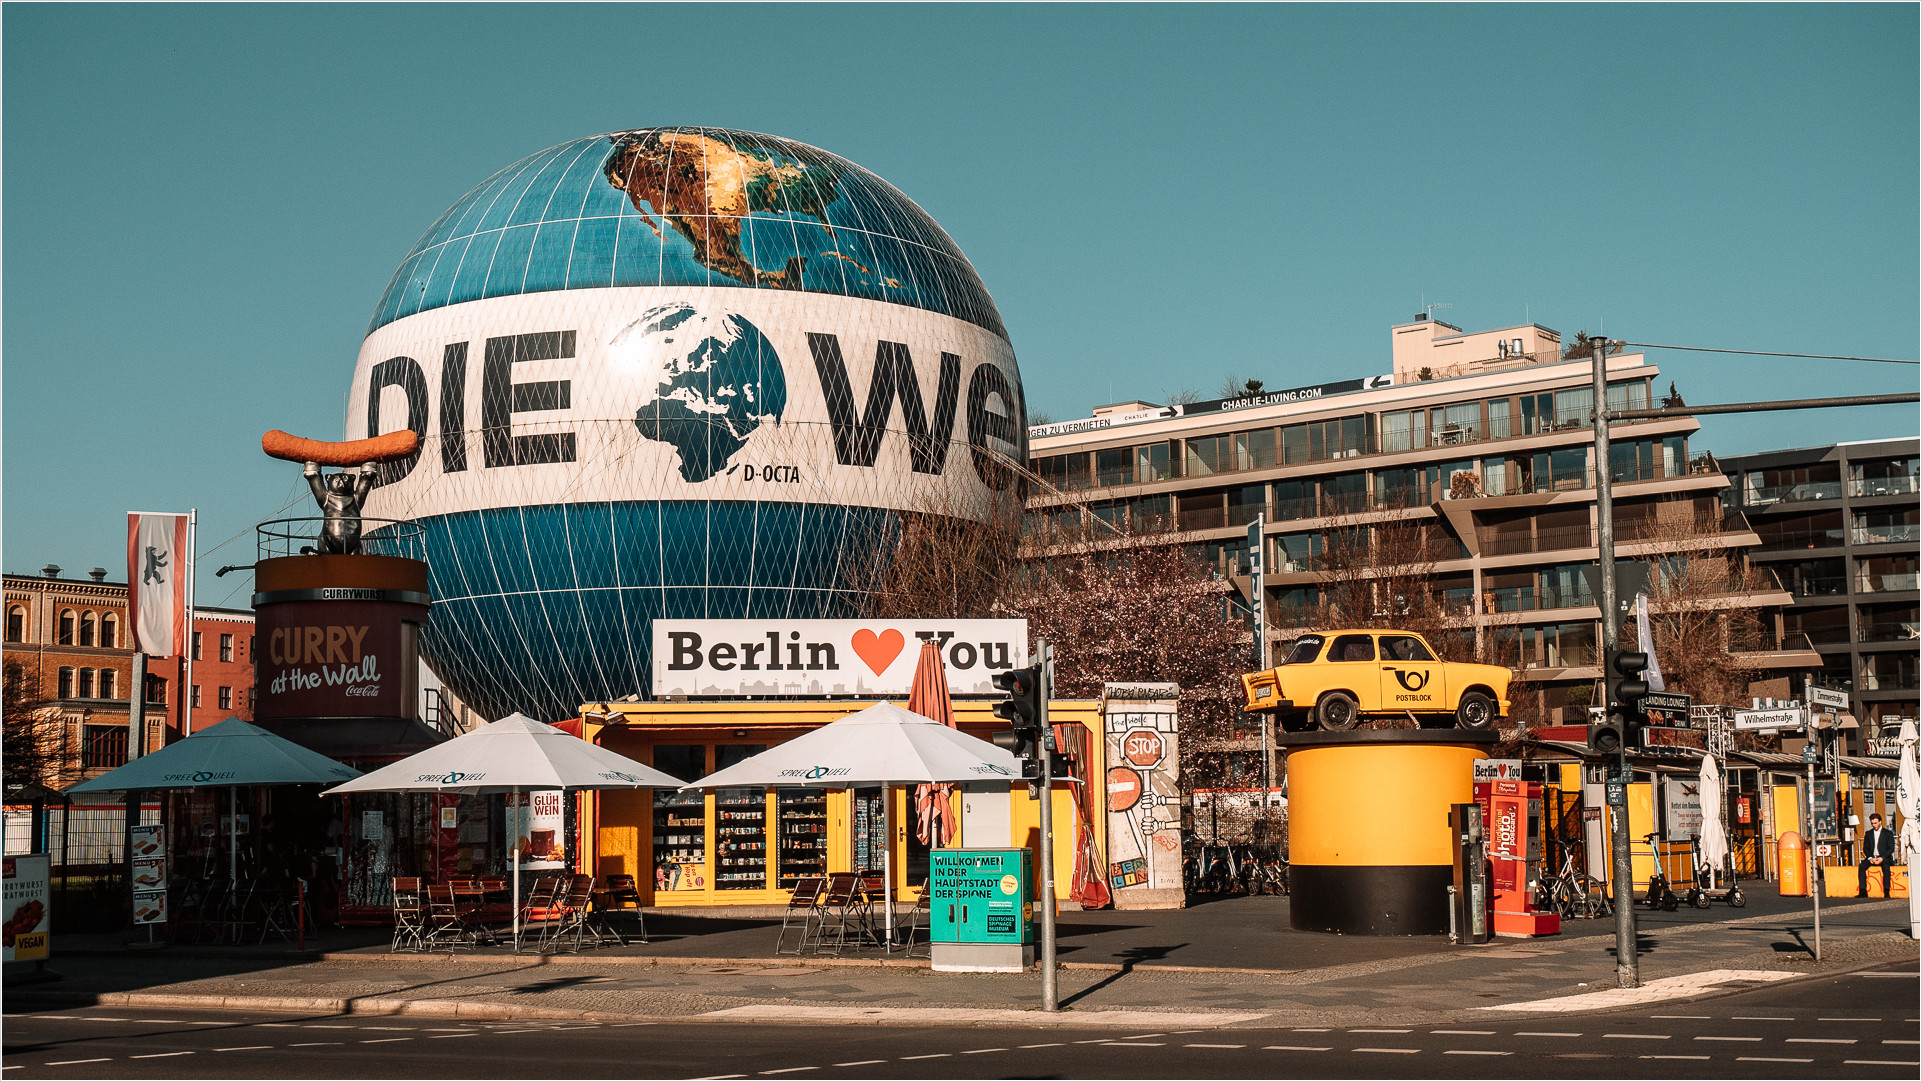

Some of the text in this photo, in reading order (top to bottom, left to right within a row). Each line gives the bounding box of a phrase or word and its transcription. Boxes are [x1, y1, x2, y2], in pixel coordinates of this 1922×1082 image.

[1221, 386, 1322, 411] CHARLIE-LIVING.COM
[368, 330, 577, 488] DIE
[1049, 426, 1061, 435] ZU
[1062, 418, 1111, 433] VERMIETEN
[322, 588, 386, 600] CURRYWURST
[270, 625, 369, 666] CURRY
[668, 631, 840, 671] Berlin
[271, 655, 382, 694] at the Wall
[1395, 694, 1432, 702] POSTBLOCK
[1645, 696, 1666, 706] LANDING
[1667, 697, 1686, 708] LOUNGE
[1743, 712, 1793, 724] Wilhelmstraße
[1128, 737, 1161, 755] STOP
[1475, 764, 1521, 778] Berlin You
[534, 793, 559, 806] GLÜH
[534, 805, 559, 816] WEIN
[935, 857, 1004, 866] WILLKOMMEN
[935, 868, 967, 877] IN DER
[935, 878, 1000, 888] HAUPTSTADT
[935, 890, 954, 899] DER
[18, 935, 44, 949] VEGAN
